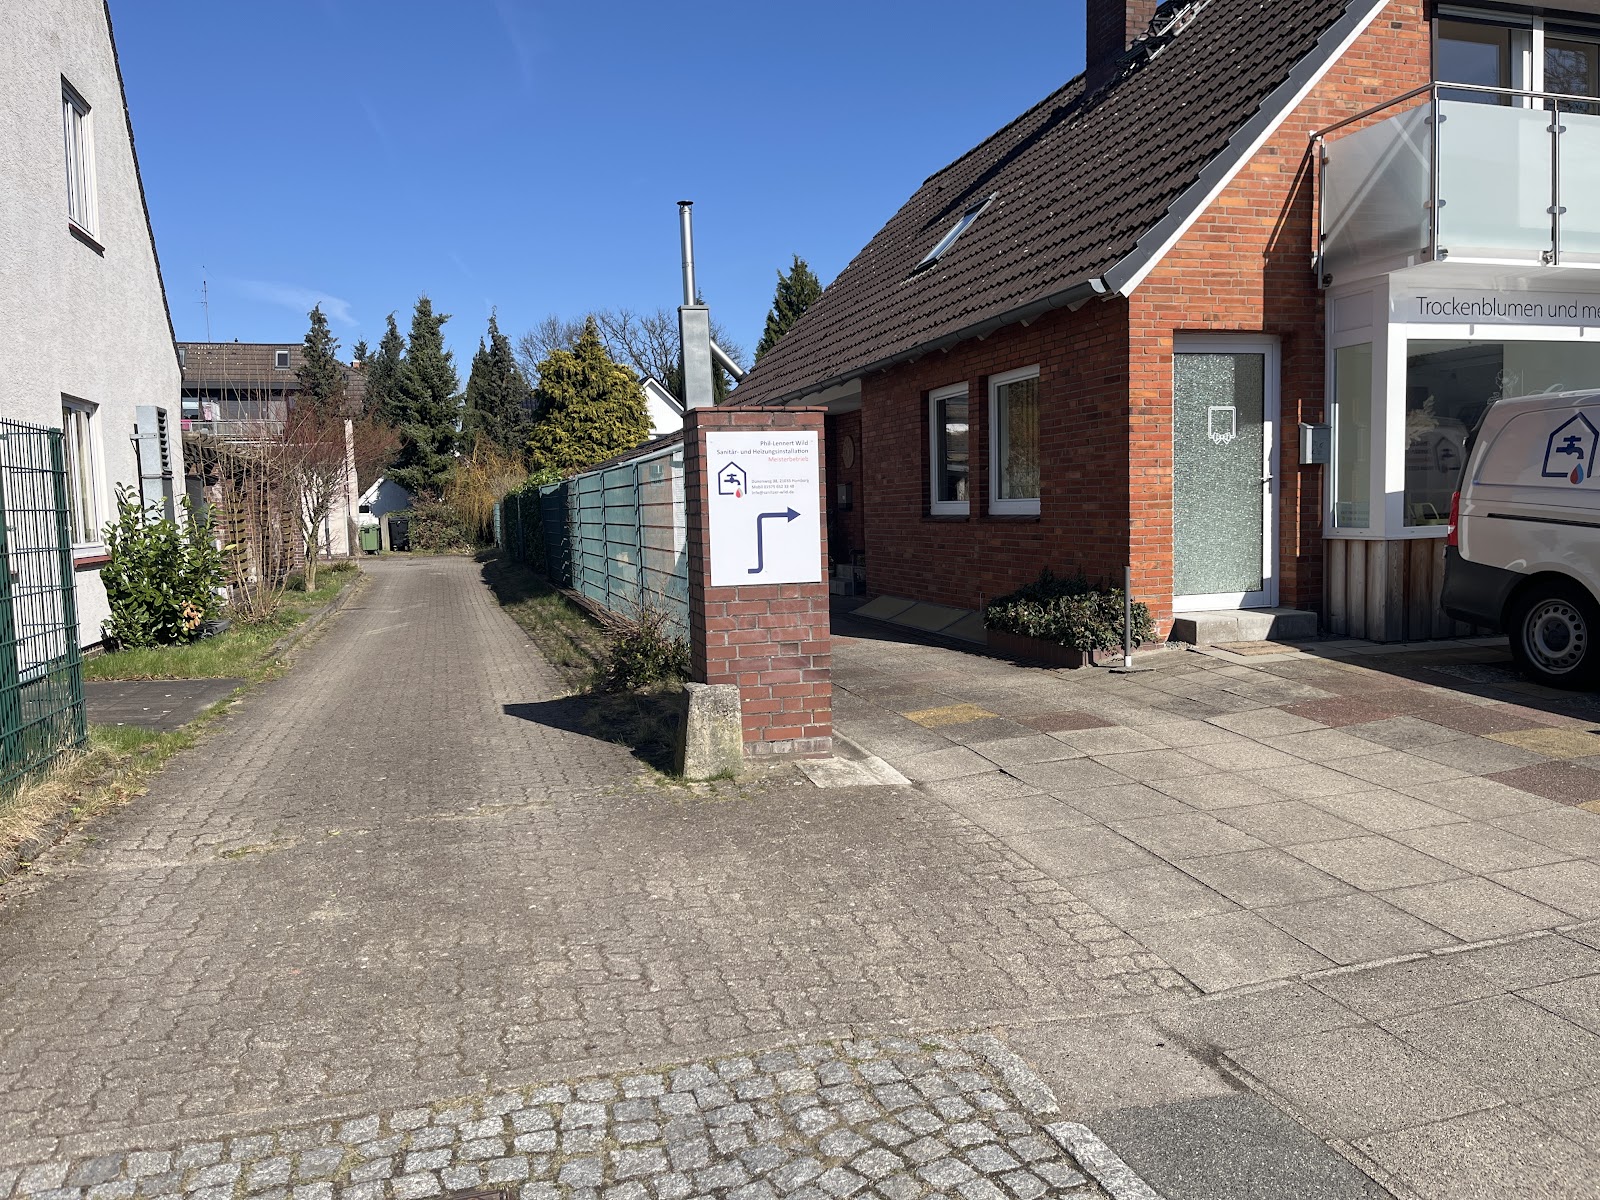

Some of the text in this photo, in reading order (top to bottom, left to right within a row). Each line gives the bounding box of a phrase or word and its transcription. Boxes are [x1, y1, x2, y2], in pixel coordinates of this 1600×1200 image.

[1416, 296, 1543, 317] Trockenblumen
[1547, 300, 1578, 318] und
[752, 448, 809, 456] Heizungsinstallation
